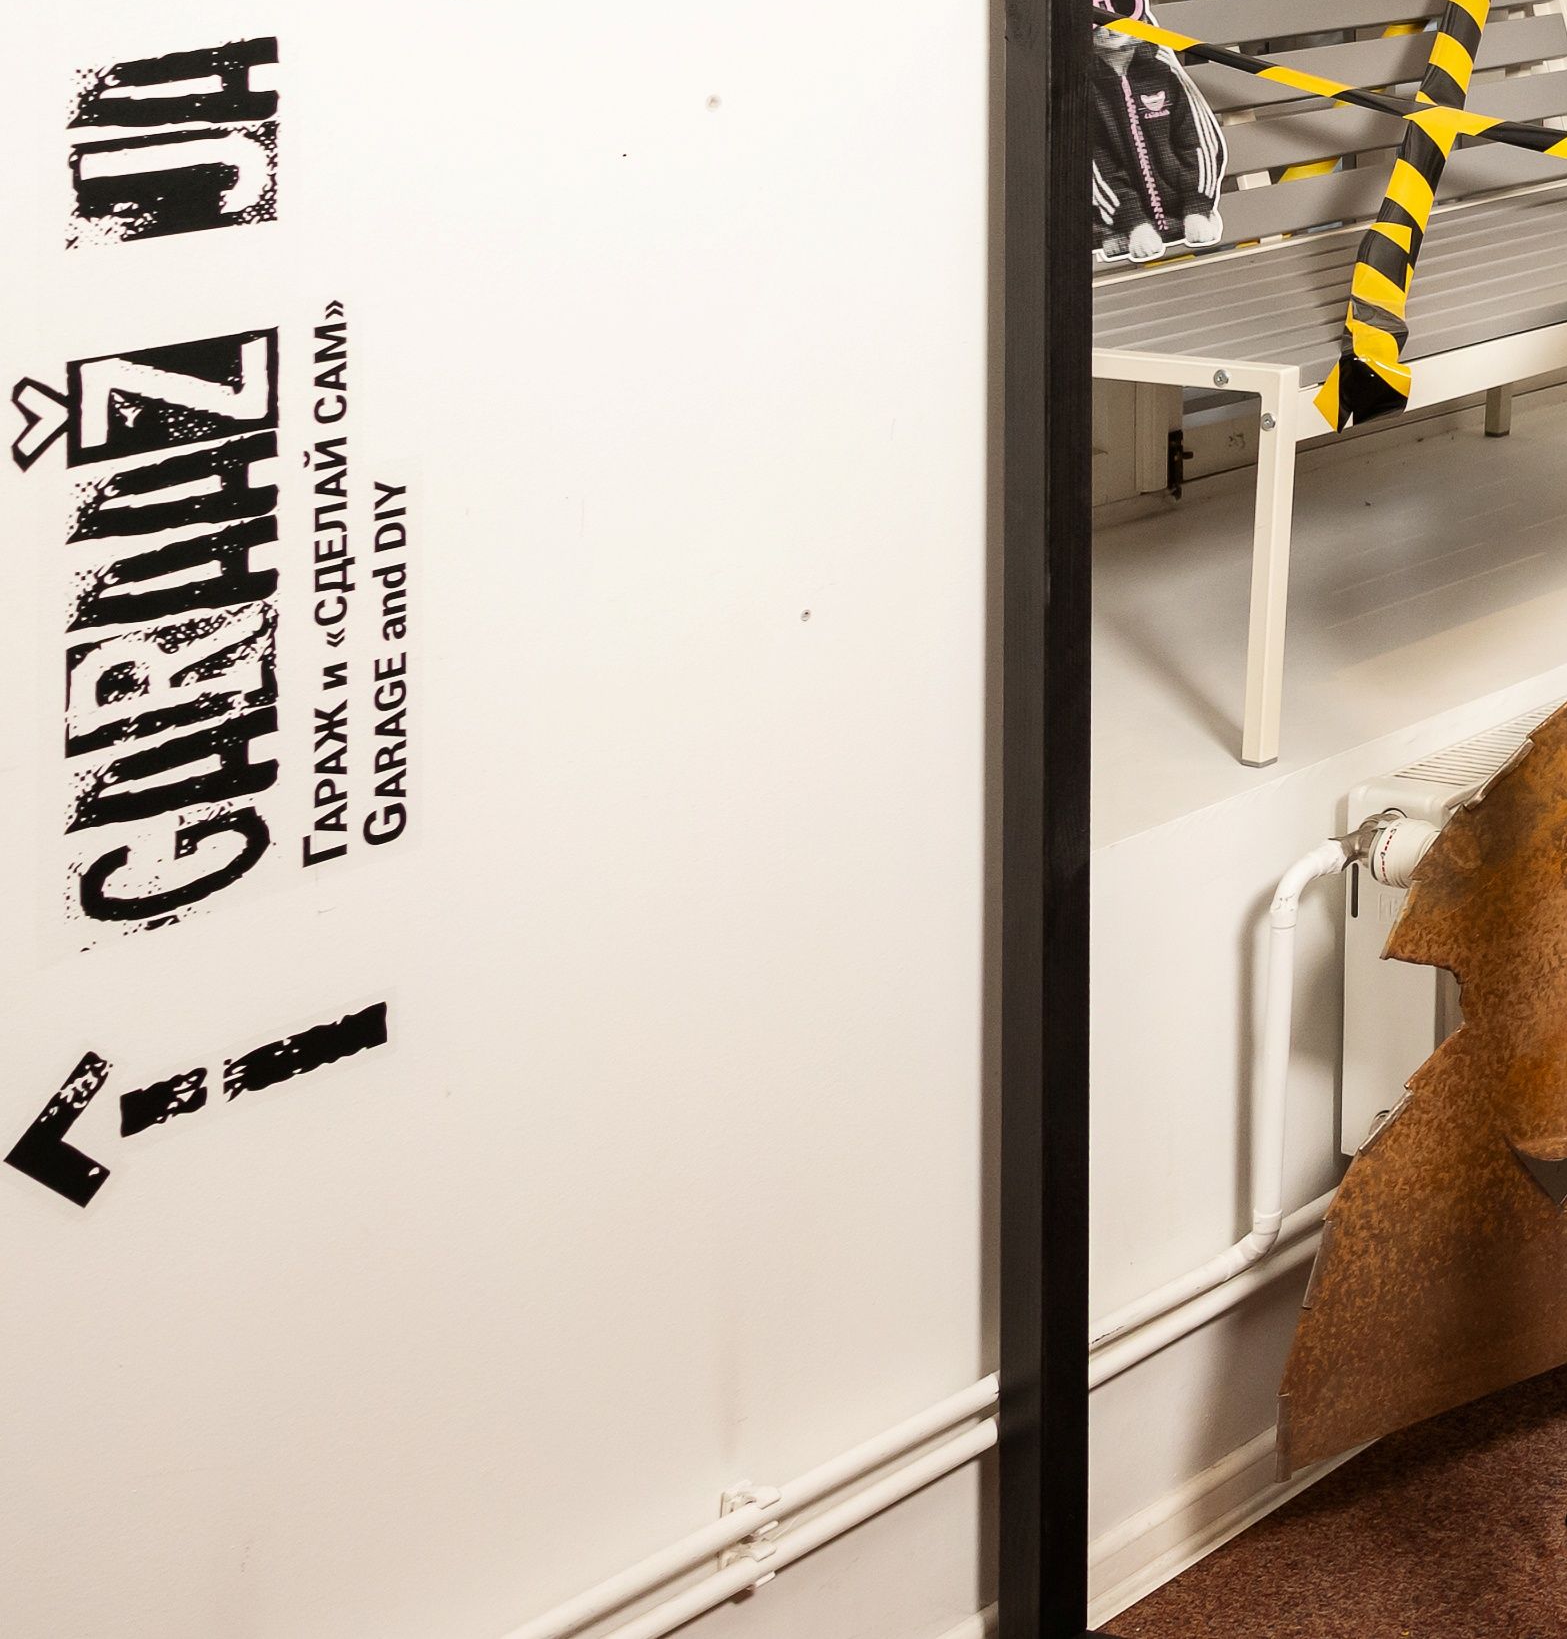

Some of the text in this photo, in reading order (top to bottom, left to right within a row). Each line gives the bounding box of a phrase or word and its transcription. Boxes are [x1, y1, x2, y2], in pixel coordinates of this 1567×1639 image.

[67, 37, 287, 248] JA
[313, 298, 350, 424] САМ»
[302, 437, 358, 651] «СДЕЛАЙ
[372, 479, 409, 551] DIY
[12, 327, 280, 936] GARAAŽ
[378, 562, 409, 639] and
[321, 660, 348, 688] и
